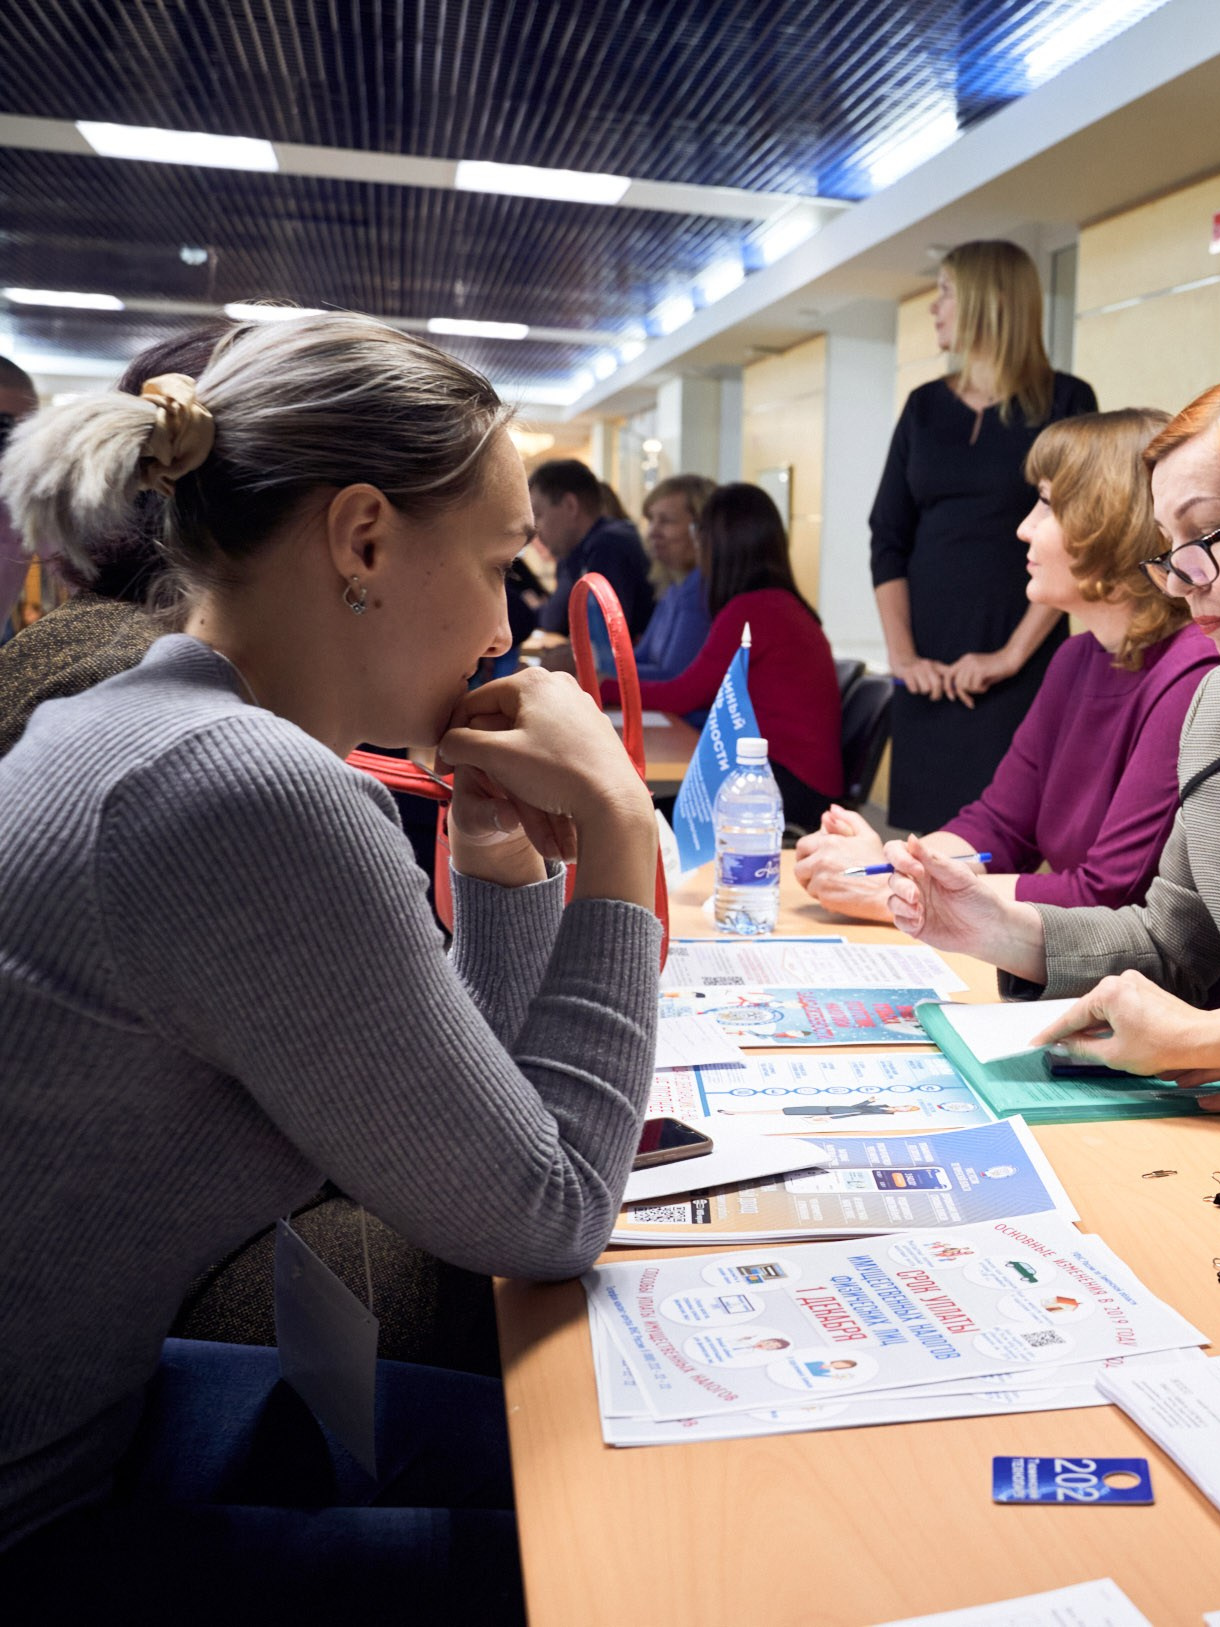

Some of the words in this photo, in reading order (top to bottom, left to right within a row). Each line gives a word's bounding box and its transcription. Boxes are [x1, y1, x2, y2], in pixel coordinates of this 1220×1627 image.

[723, 673, 746, 730] ИНЫЙ
[994, 1223, 1056, 1257] ОСНОВНЫЕ
[639, 1268, 660, 1293] СПОСОБЫ
[1053, 1258, 1108, 1296] ИЗМЕНЕНИЯ
[637, 1296, 656, 1318] УПЛАТЫ
[796, 1296, 868, 1342] ДЕКАБРЯ
[830, 1275, 893, 1327] ФИЗИЧЕСКИХ
[872, 1328, 909, 1347] ЛИЦ
[847, 1255, 927, 1323] ИМУЩЕСТВЕННЫХ
[907, 1323, 961, 1360] НАЛОГОВ
[896, 1269, 941, 1294] СРОК
[920, 1295, 981, 1335] УПЛАТЫ
[1104, 1306, 1129, 1324] 2019
[644, 1321, 696, 1373] ИМУЩЕСТВЕННЫХ
[1115, 1328, 1138, 1347] ГОДУ
[691, 1374, 739, 1401] НАЛОГОВ
[1054, 1458, 1100, 1501] 202
